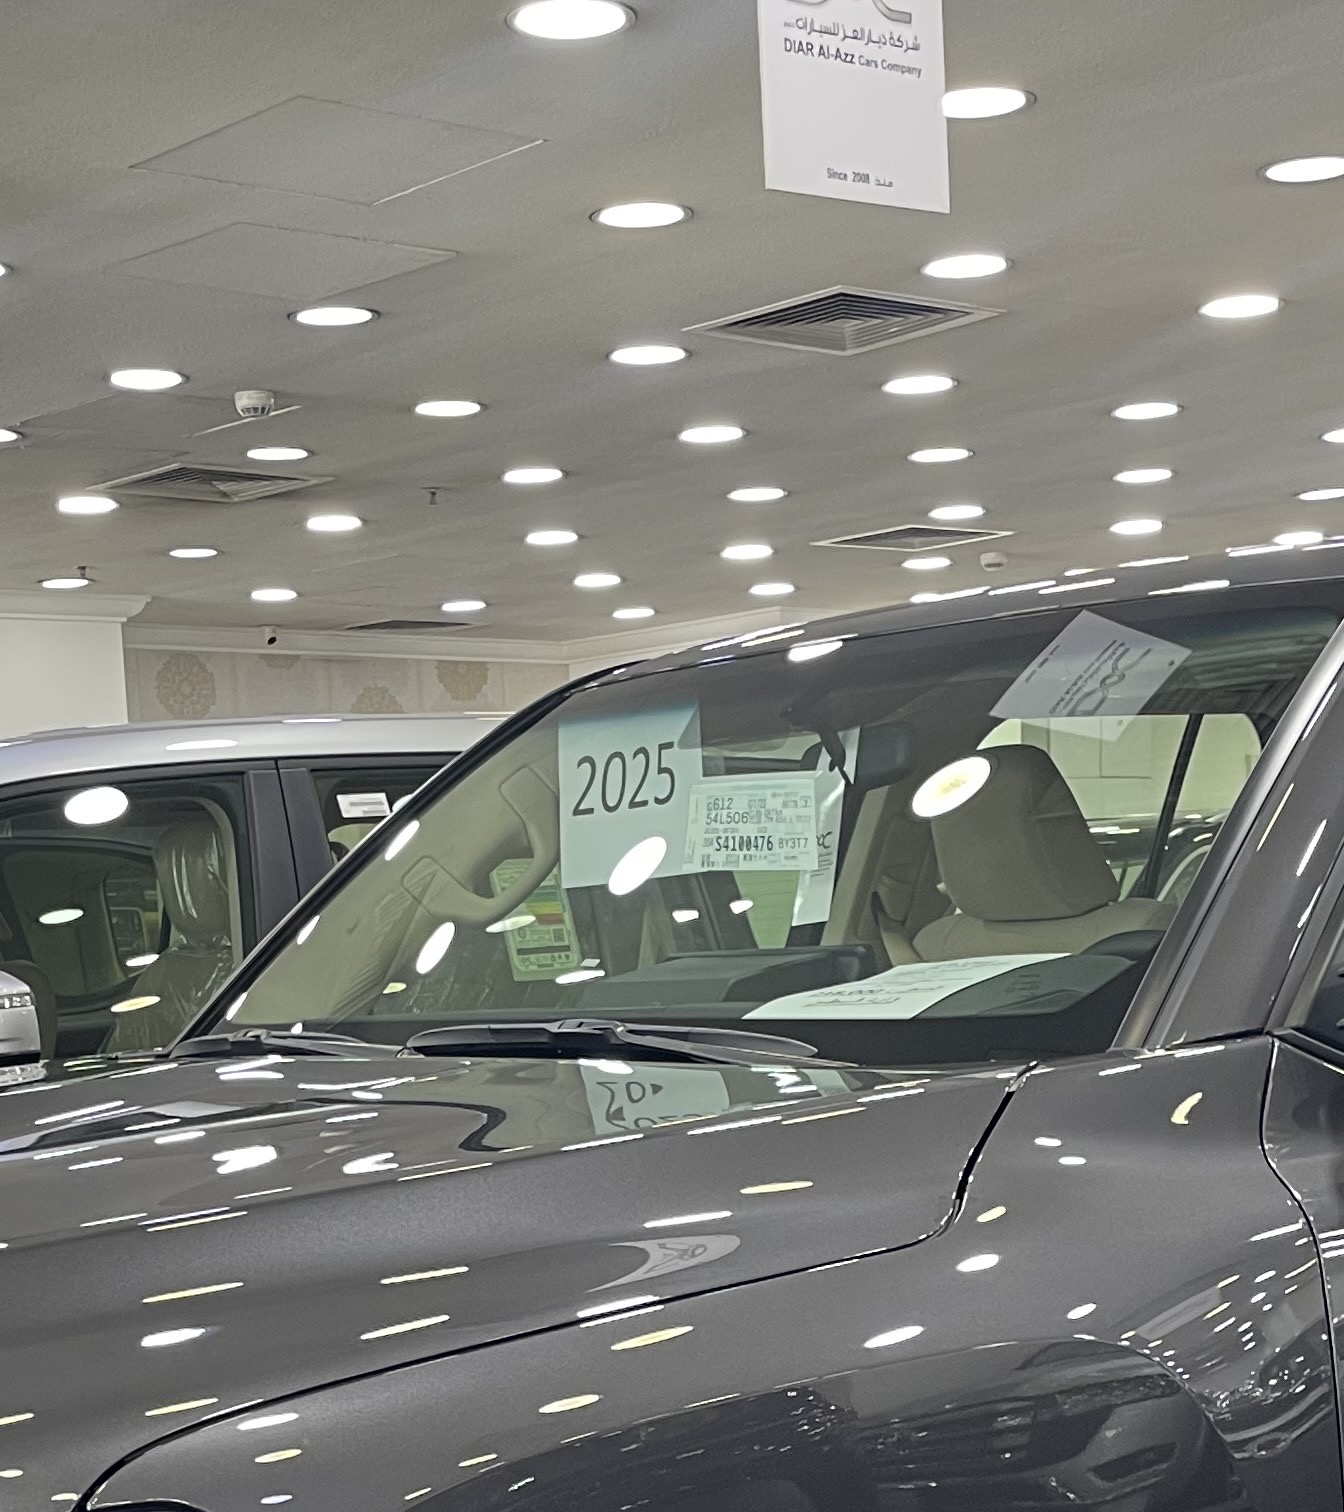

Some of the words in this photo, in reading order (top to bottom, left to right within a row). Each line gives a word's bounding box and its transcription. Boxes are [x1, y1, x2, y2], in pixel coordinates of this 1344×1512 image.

[796, 16, 840, 38] للسيارات
[841, 23, 866, 42] العز
[865, 28, 888, 49] ديار
[889, 31, 921, 53] شركة
[784, 37, 815, 58] DIAR
[818, 44, 856, 65] Al-Azz
[858, 54, 879, 69] Cars
[881, 59, 922, 79] Company
[826, 167, 848, 182] Since
[572, 741, 676, 817] 2025
